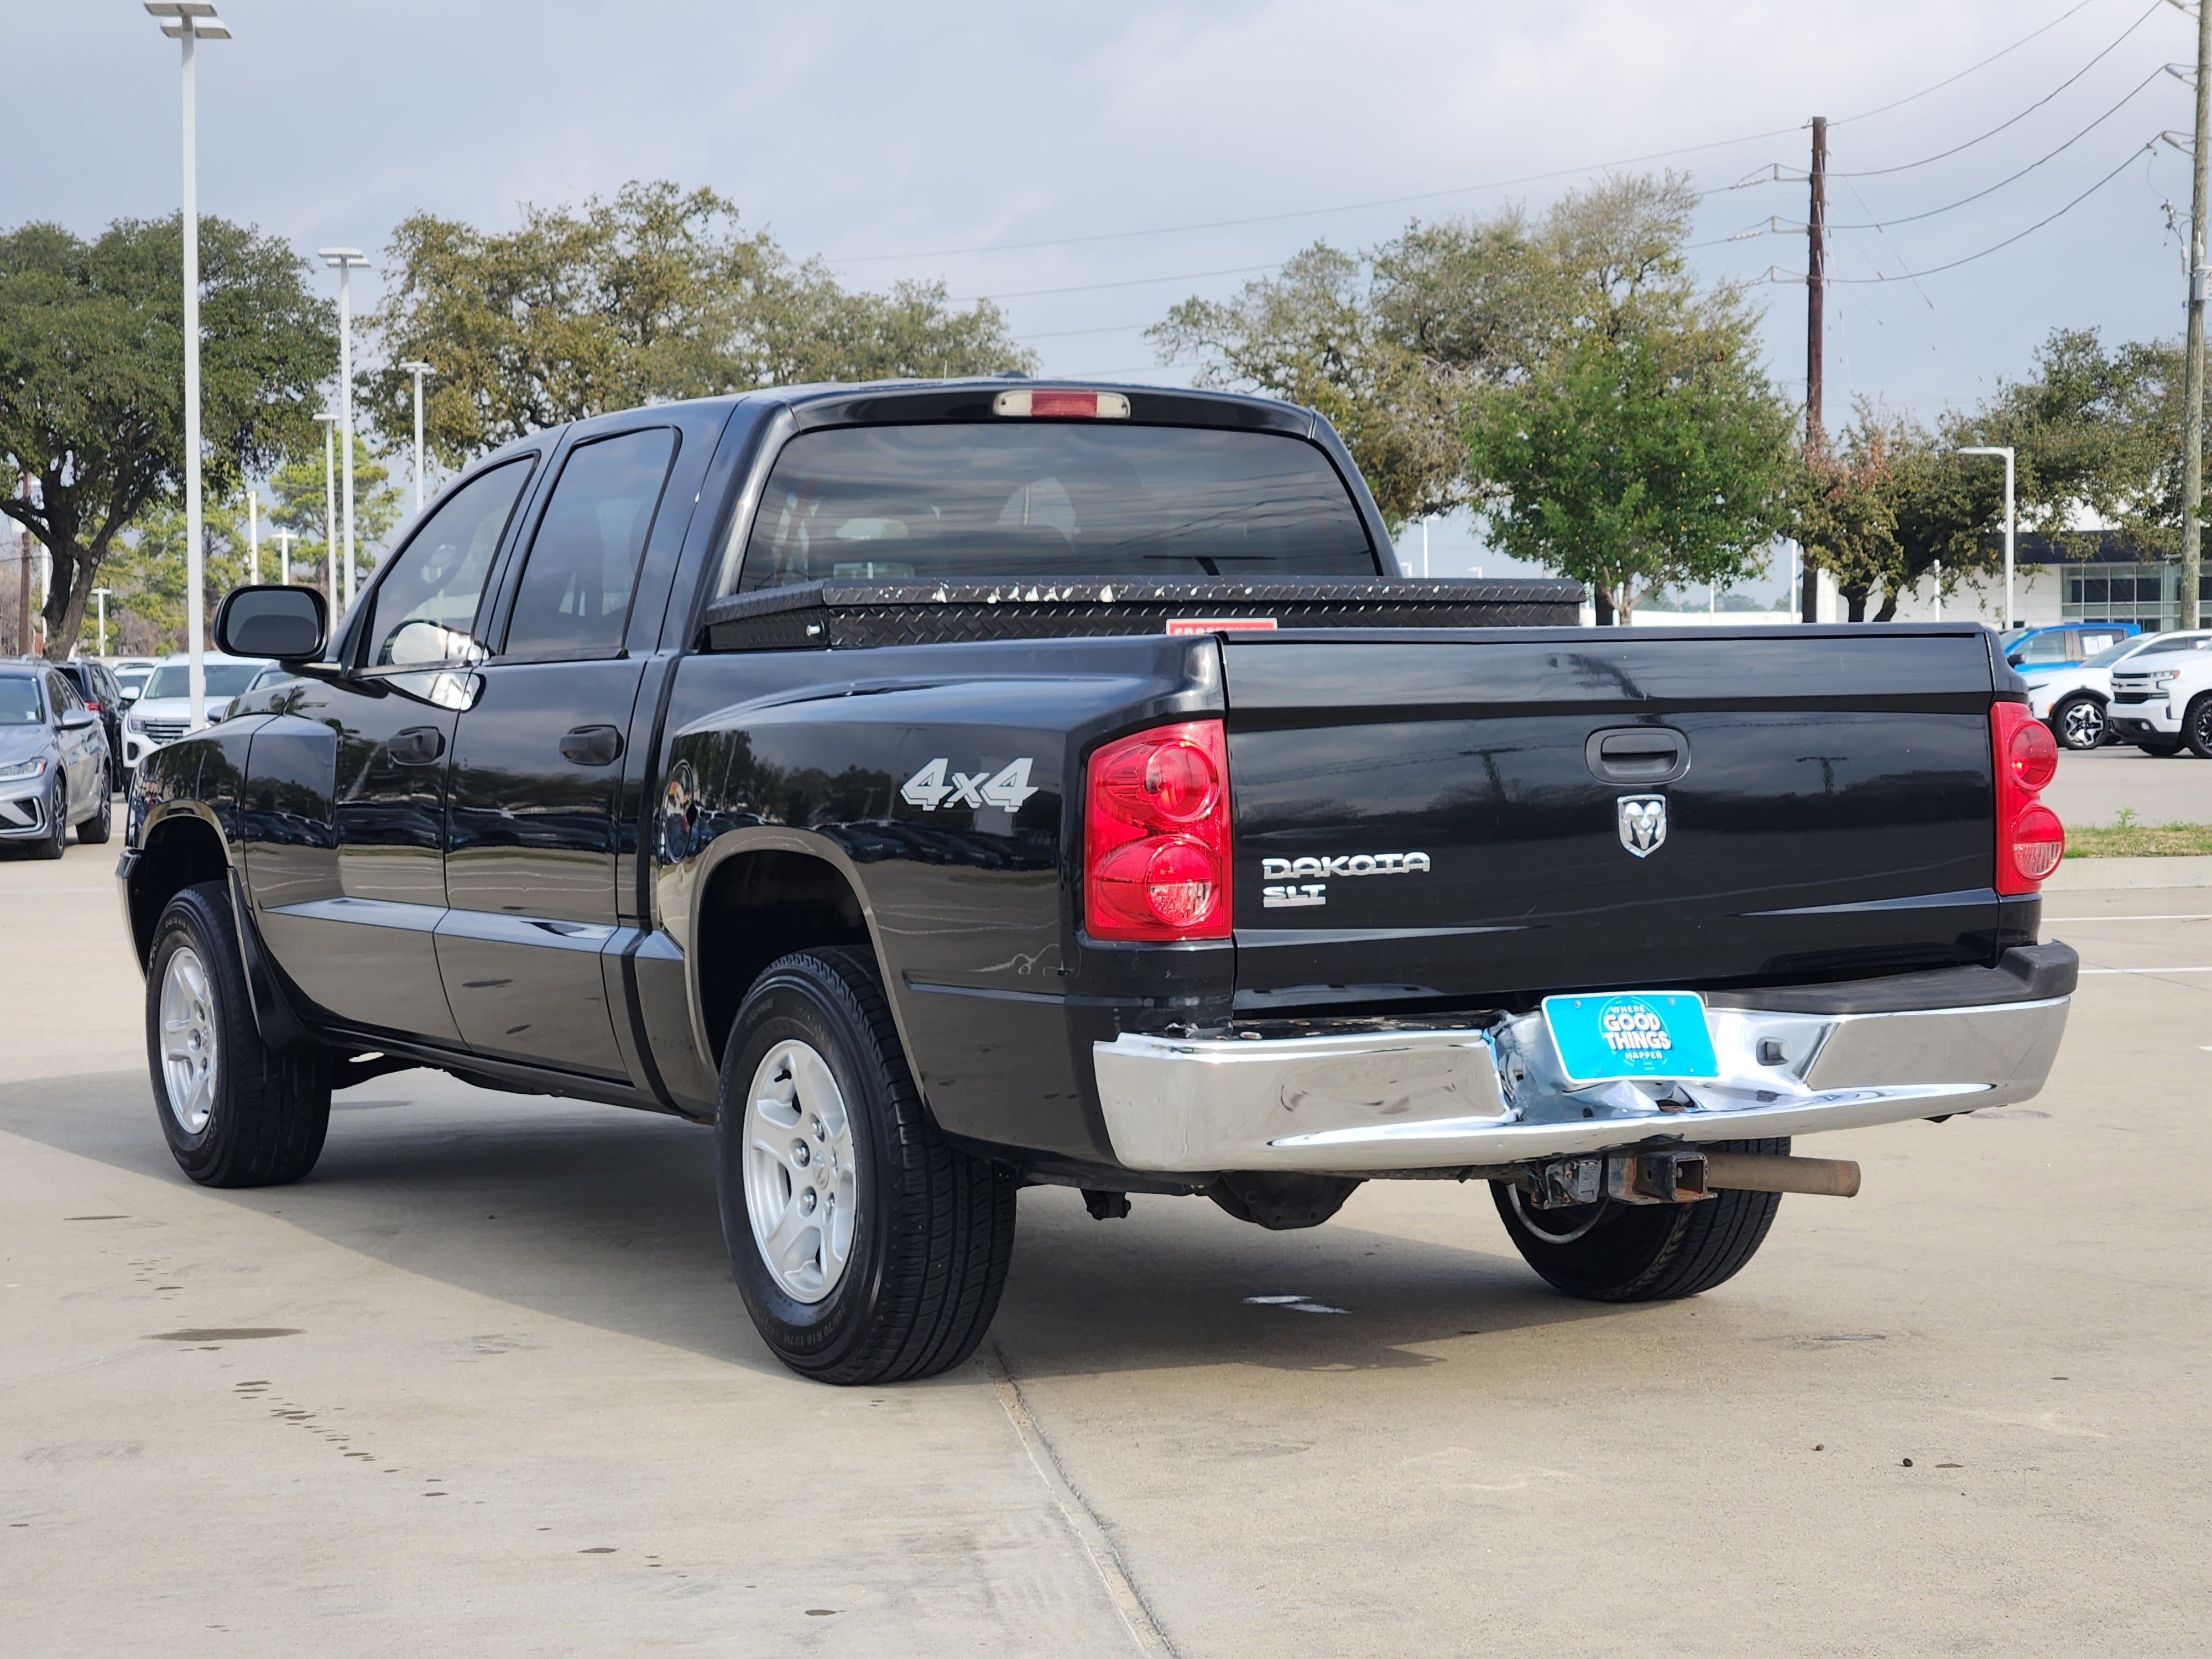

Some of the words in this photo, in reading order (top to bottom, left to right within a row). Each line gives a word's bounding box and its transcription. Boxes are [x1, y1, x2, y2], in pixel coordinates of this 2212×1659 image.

[900, 758, 1039, 812] 4x4
[1262, 852, 1431, 879] DAKOTA
[1263, 884, 1326, 902] SLT
[1610, 1004, 1646, 1014] WHERE
[1603, 1013, 1661, 1032] GOOD
[1603, 1030, 1672, 1050] THINGS
[1625, 1051, 1663, 1060] HAPPEN
